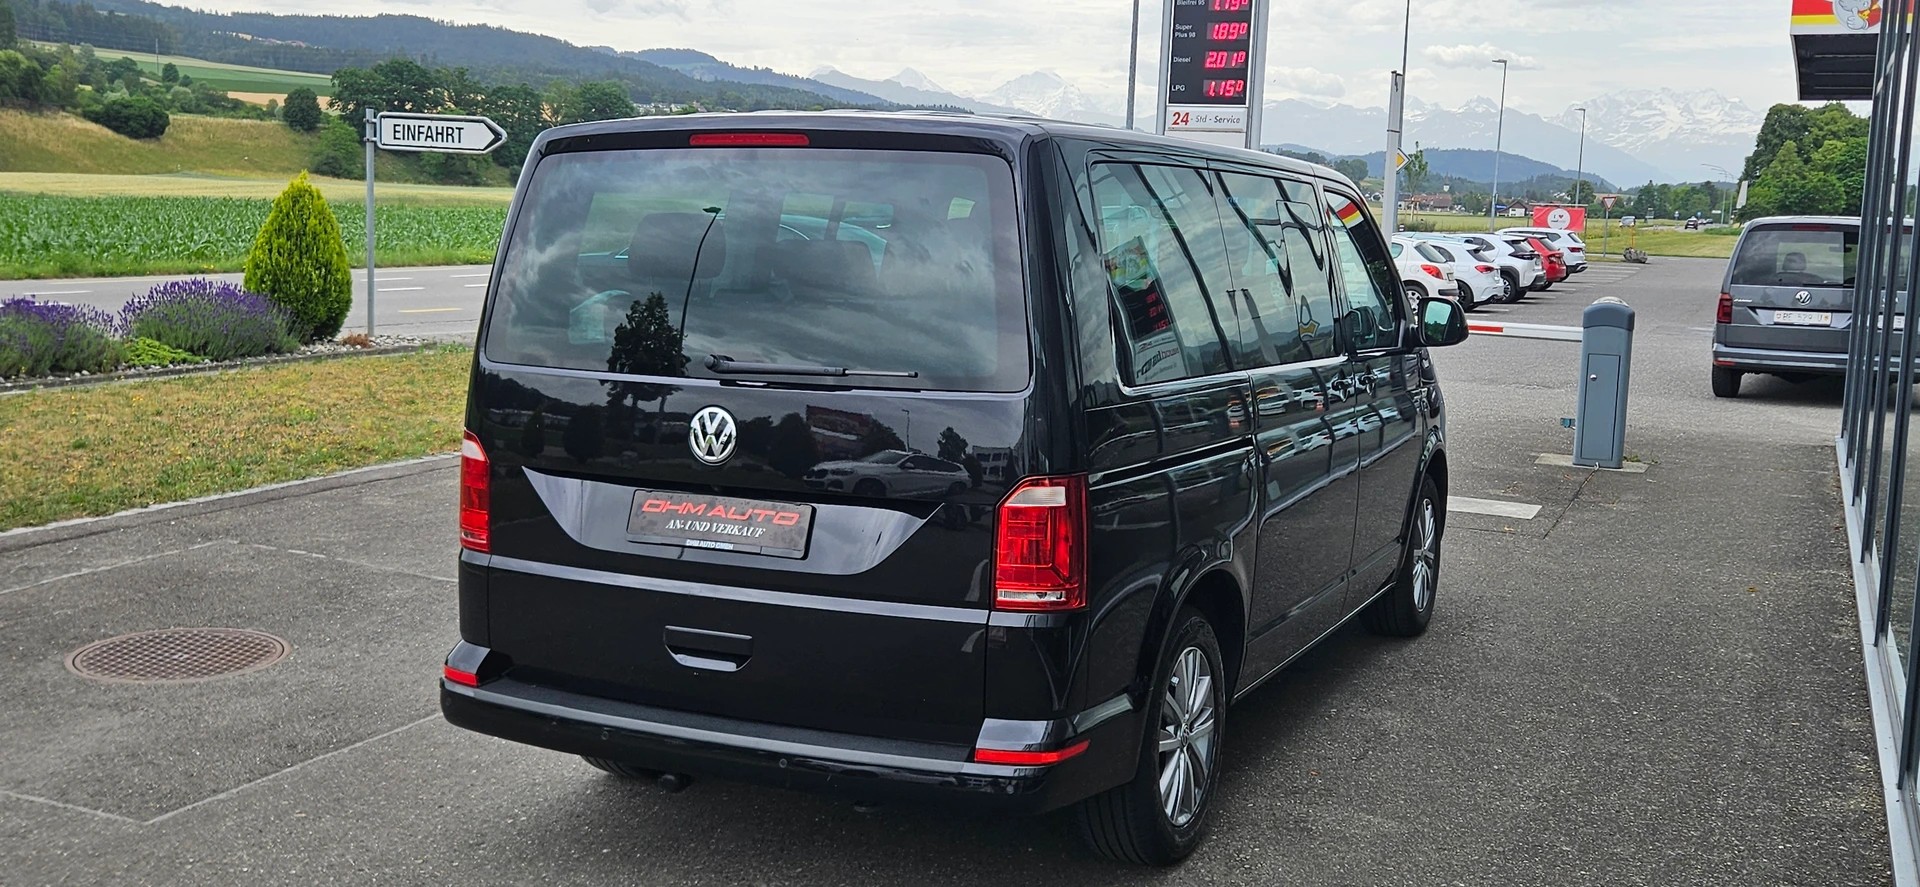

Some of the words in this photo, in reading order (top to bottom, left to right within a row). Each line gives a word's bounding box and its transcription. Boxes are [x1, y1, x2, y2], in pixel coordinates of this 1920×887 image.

[1171, 84, 1186, 92] LPG
[1171, 111, 1190, 126] 24
[1213, 115, 1241, 124] Service
[393, 123, 464, 143] EINFAHRT
[708, 505, 800, 526] AUTO
[685, 520, 710, 531] UND
[711, 522, 766, 538] VERKAUF
[699, 540, 716, 548] AUTO
